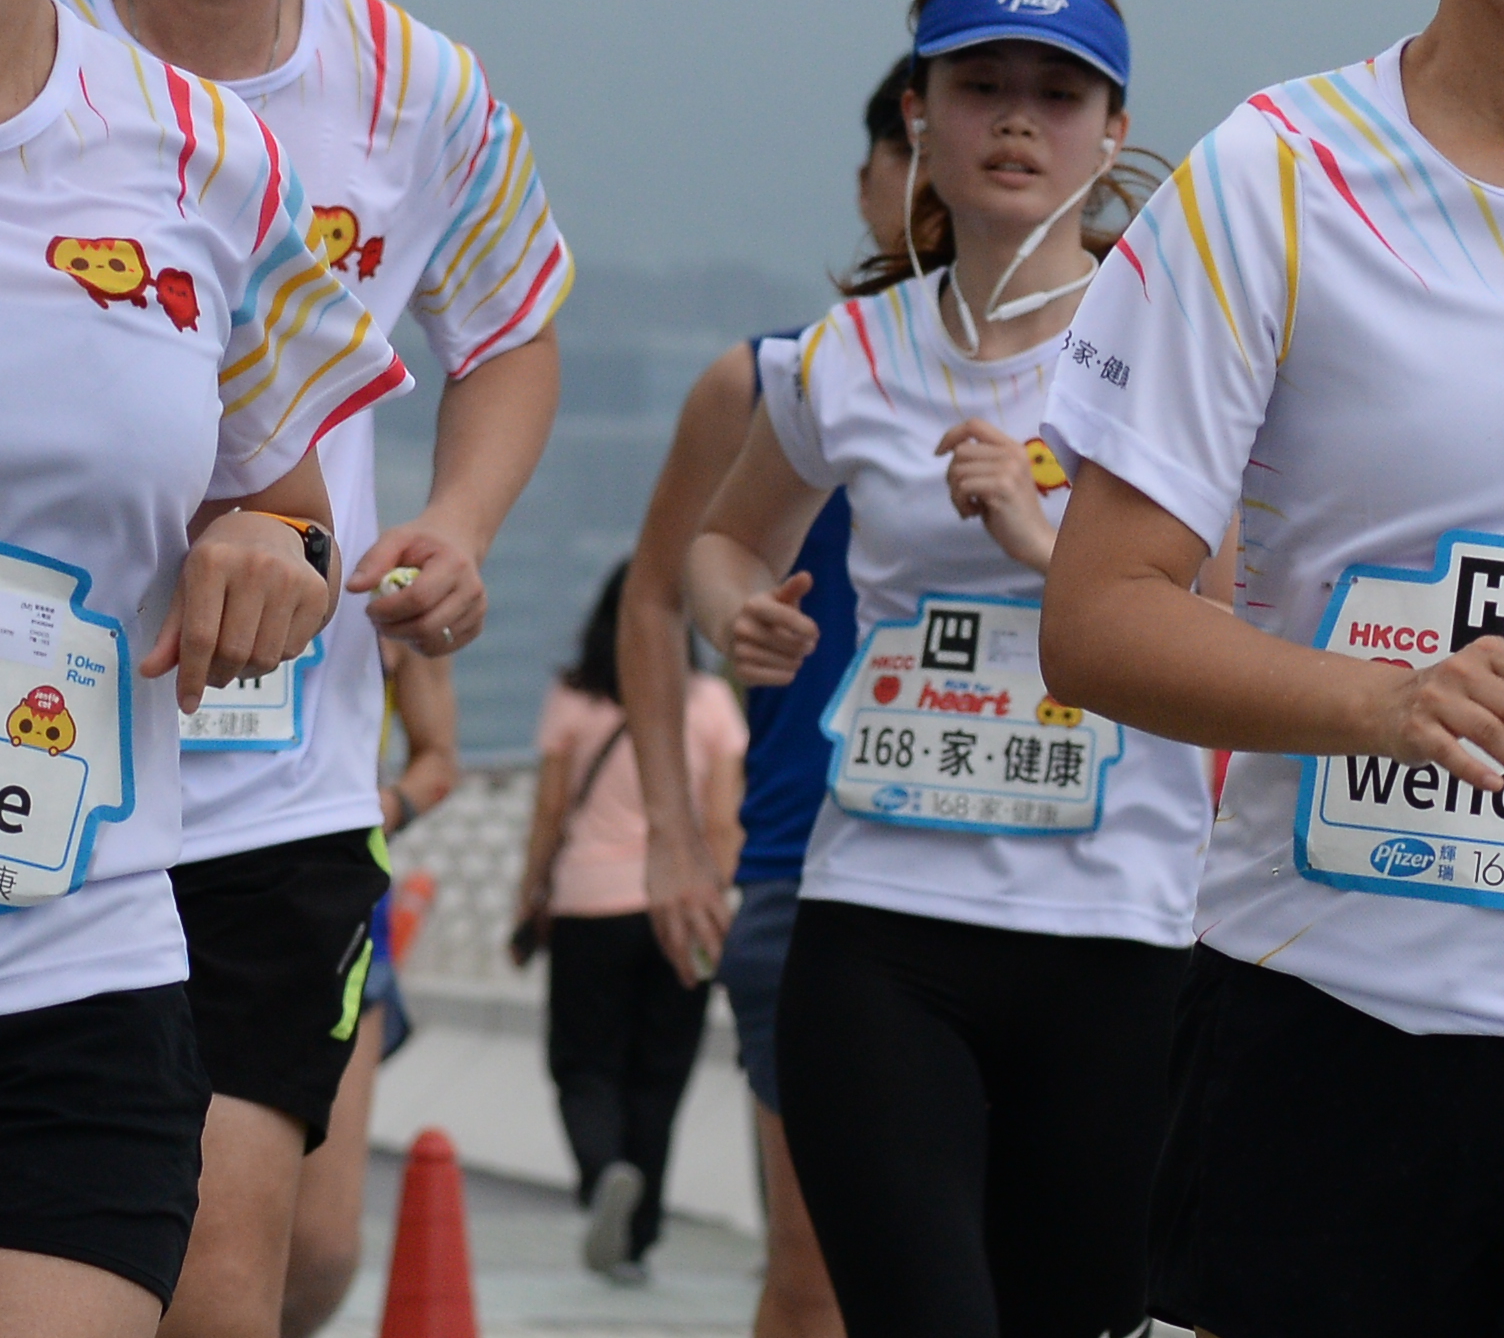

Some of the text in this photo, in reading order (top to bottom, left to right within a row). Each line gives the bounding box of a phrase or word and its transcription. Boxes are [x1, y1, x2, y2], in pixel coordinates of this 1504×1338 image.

[1349, 621, 1439, 654] HKCC
[66, 652, 105, 674] 10km
[66, 669, 96, 687] Run
[917, 677, 1011, 716] heart
[1374, 842, 1435, 877] Pfizer
